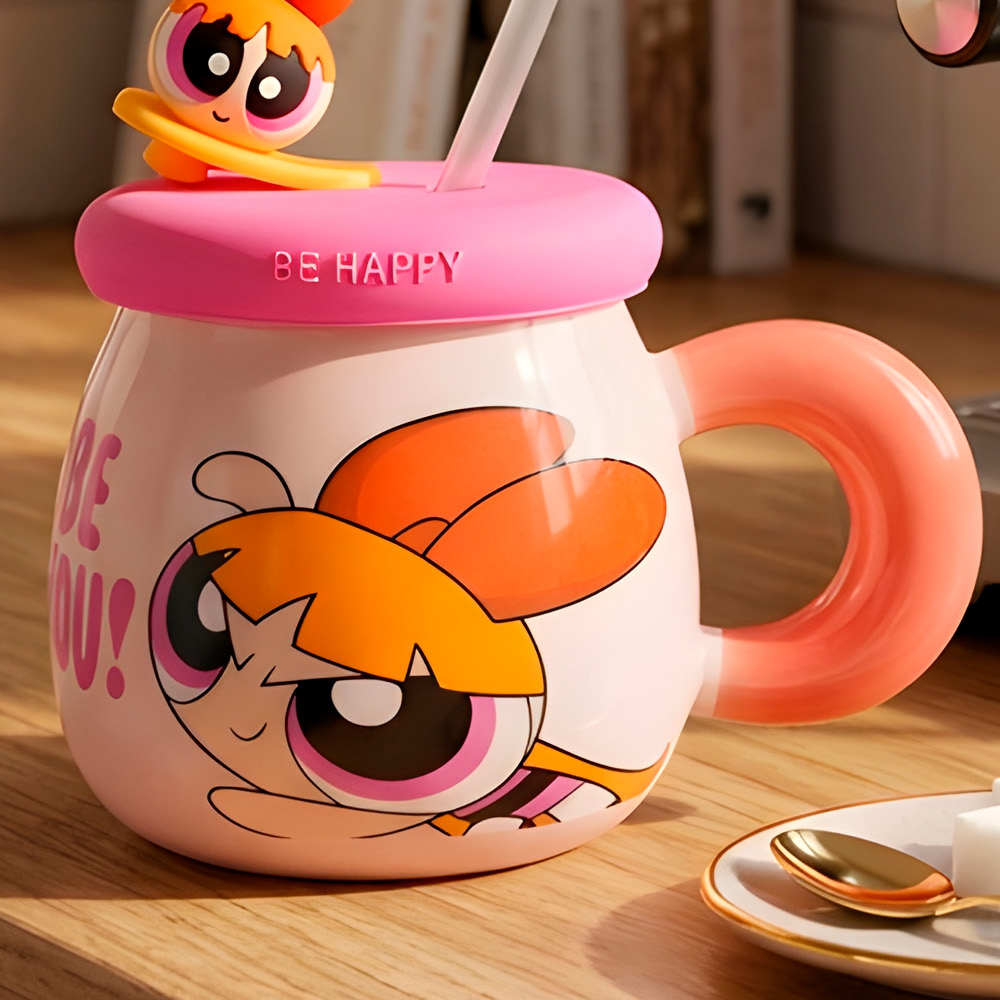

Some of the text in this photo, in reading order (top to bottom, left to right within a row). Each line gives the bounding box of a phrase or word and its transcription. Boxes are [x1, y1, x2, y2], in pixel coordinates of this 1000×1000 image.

[274, 251, 463, 285] BE HAPPY
[58, 418, 122, 551] BE
[51, 542, 136, 700] OU!
